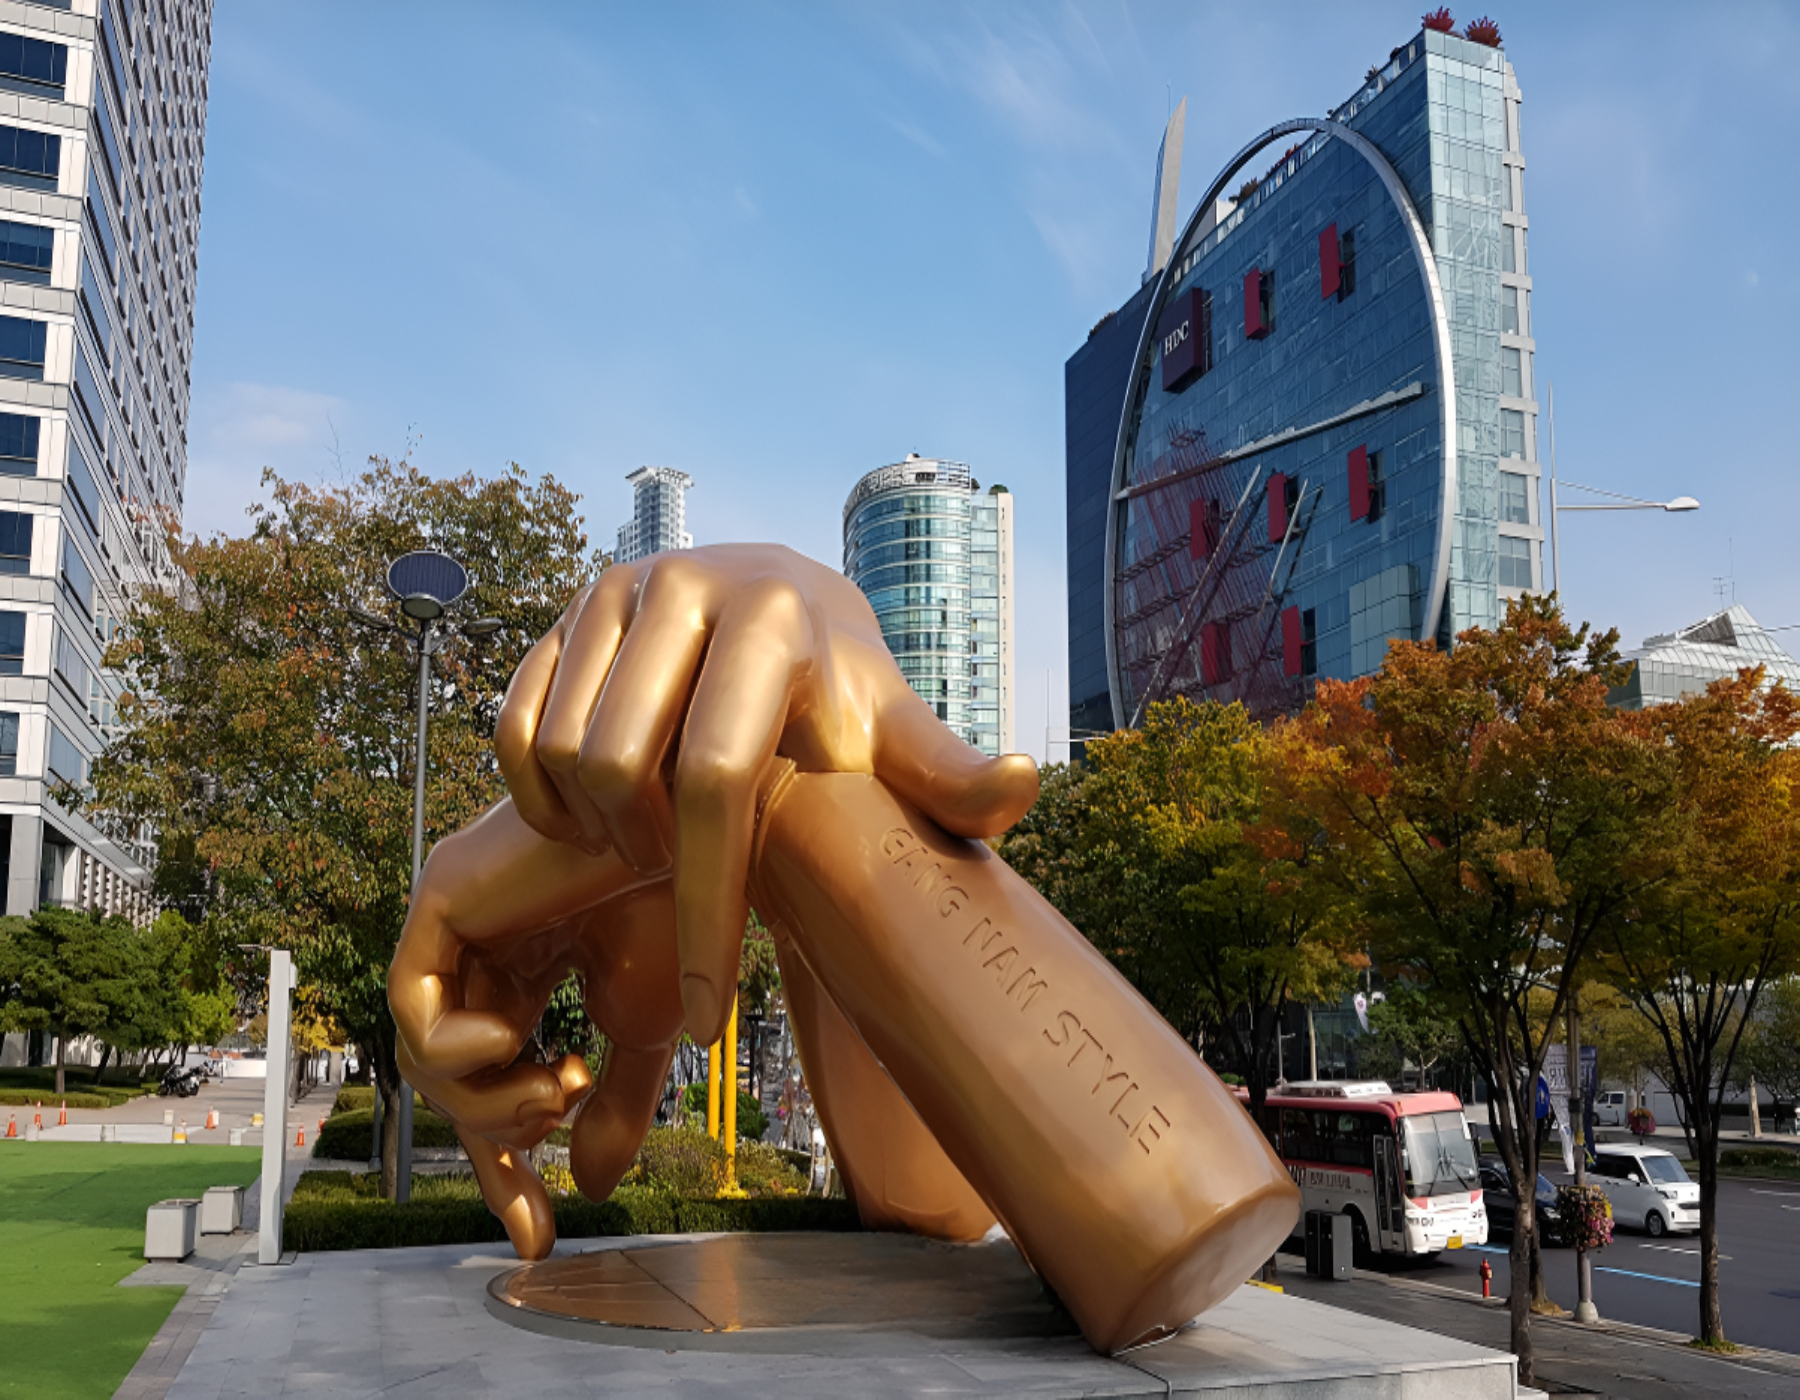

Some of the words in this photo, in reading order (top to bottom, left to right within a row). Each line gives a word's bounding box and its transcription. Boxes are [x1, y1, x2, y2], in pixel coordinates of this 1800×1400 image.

[1165, 320, 1189, 356] HDC
[879, 827, 970, 919] GANG
[962, 916, 1049, 1013] NAM
[1042, 1009, 1171, 1156] STYLE
